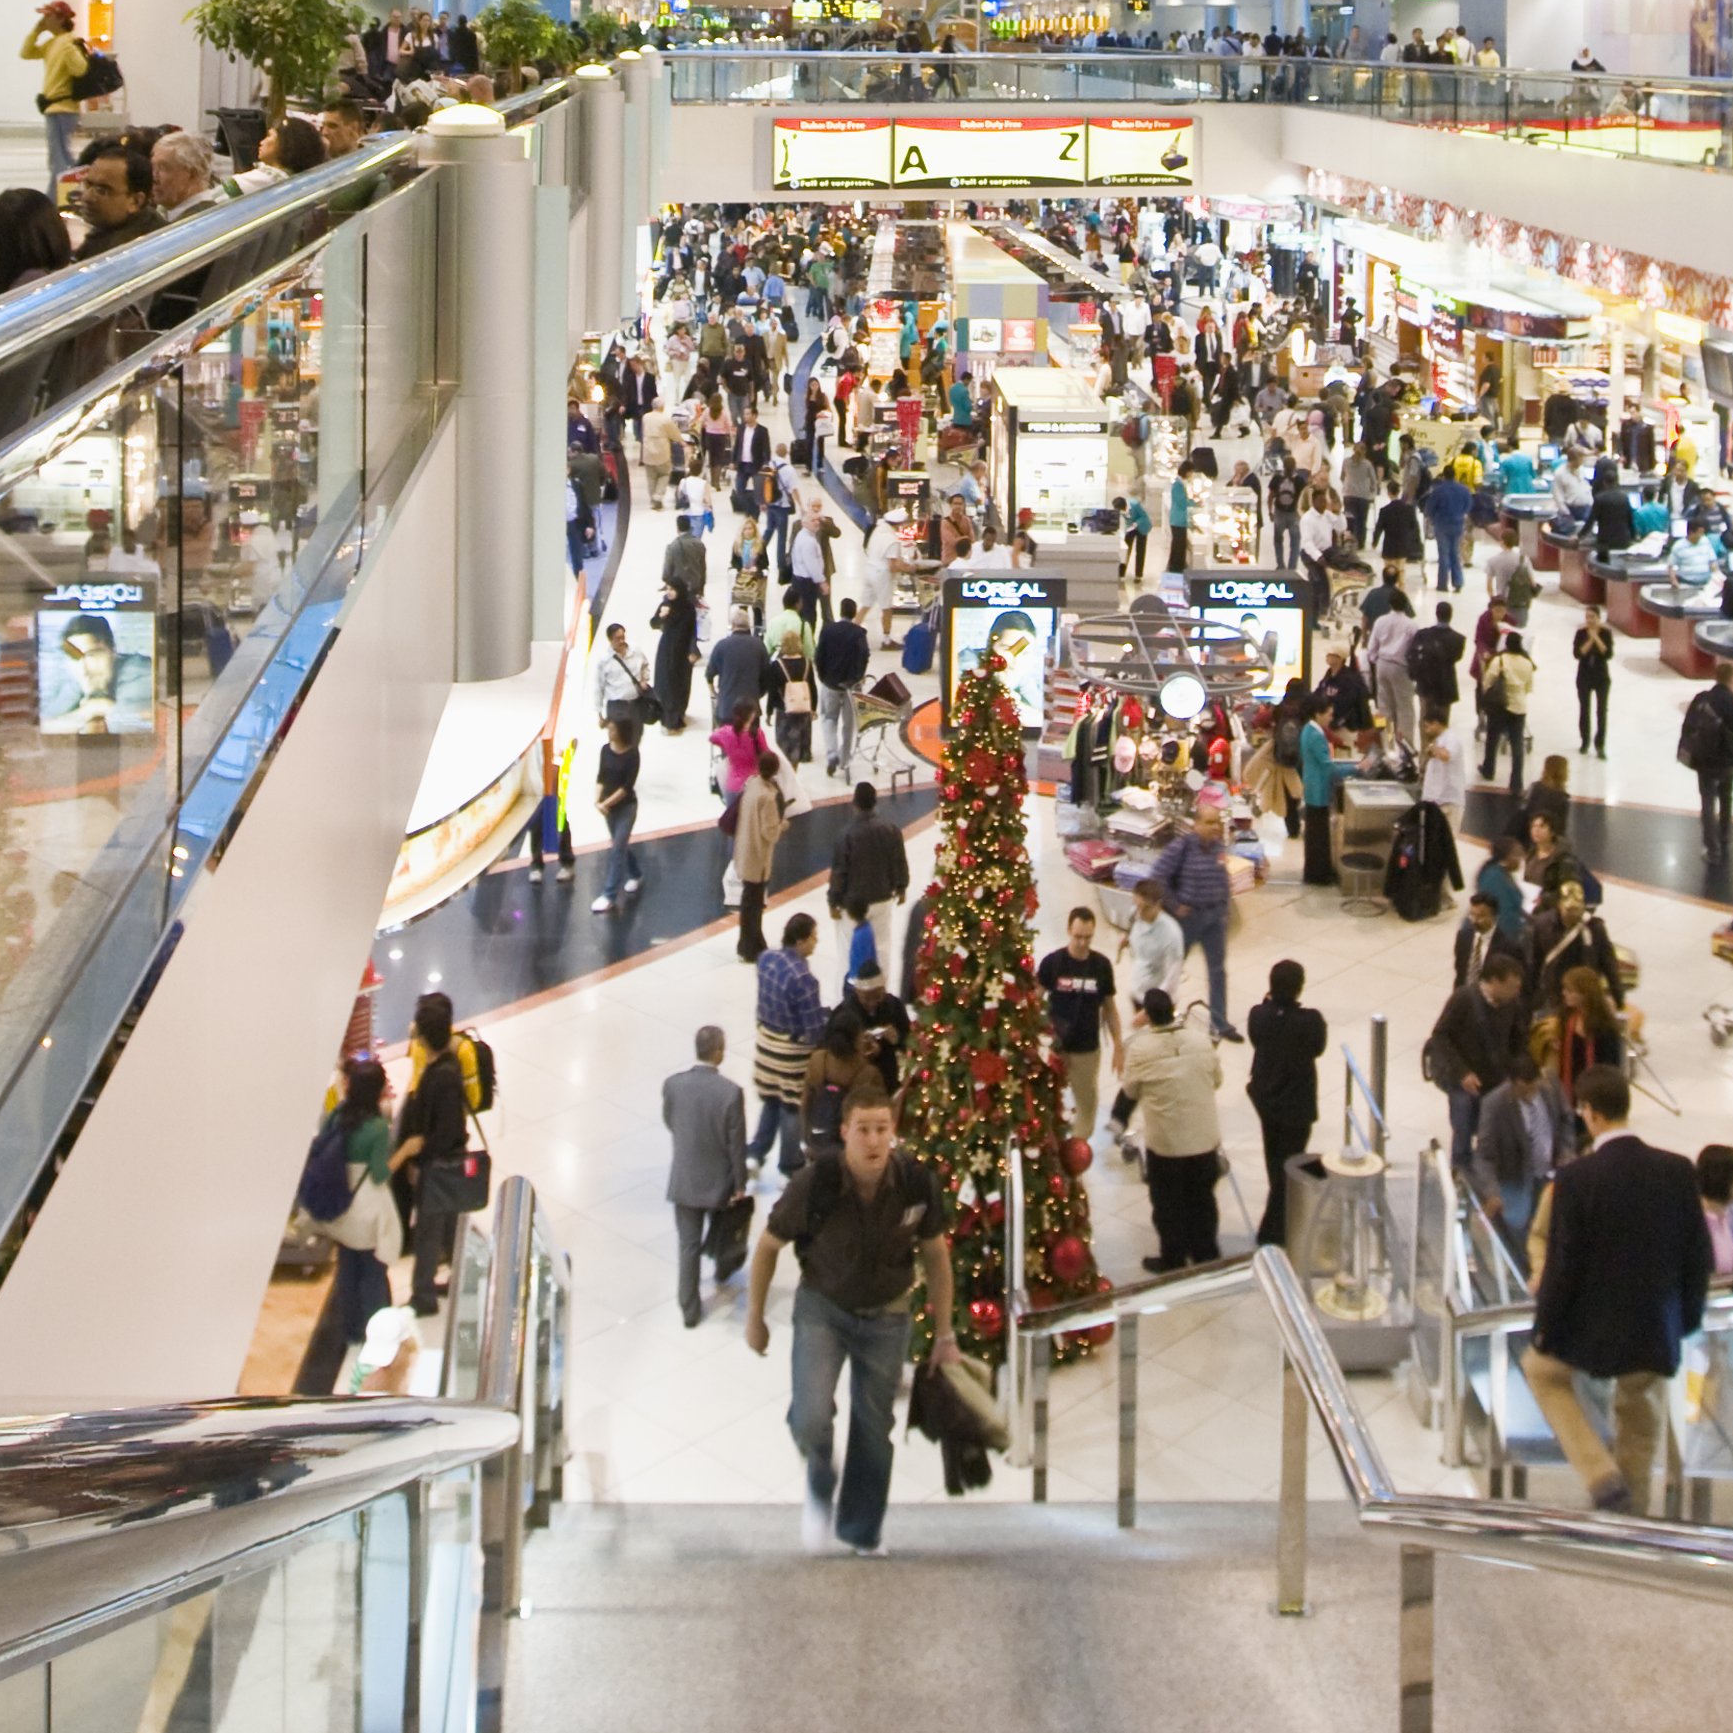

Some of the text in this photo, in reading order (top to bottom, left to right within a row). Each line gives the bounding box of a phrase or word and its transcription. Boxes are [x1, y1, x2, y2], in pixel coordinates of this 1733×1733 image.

[826, 121, 846, 132] Duty
[847, 121, 865, 130] Free
[985, 120, 1003, 130] Duty
[1004, 120, 1022, 128] Free
[1135, 120, 1153, 130] Duty
[1154, 120, 1171, 128] Free
[1058, 132, 1080, 161] Z
[899, 145, 929, 175] A
